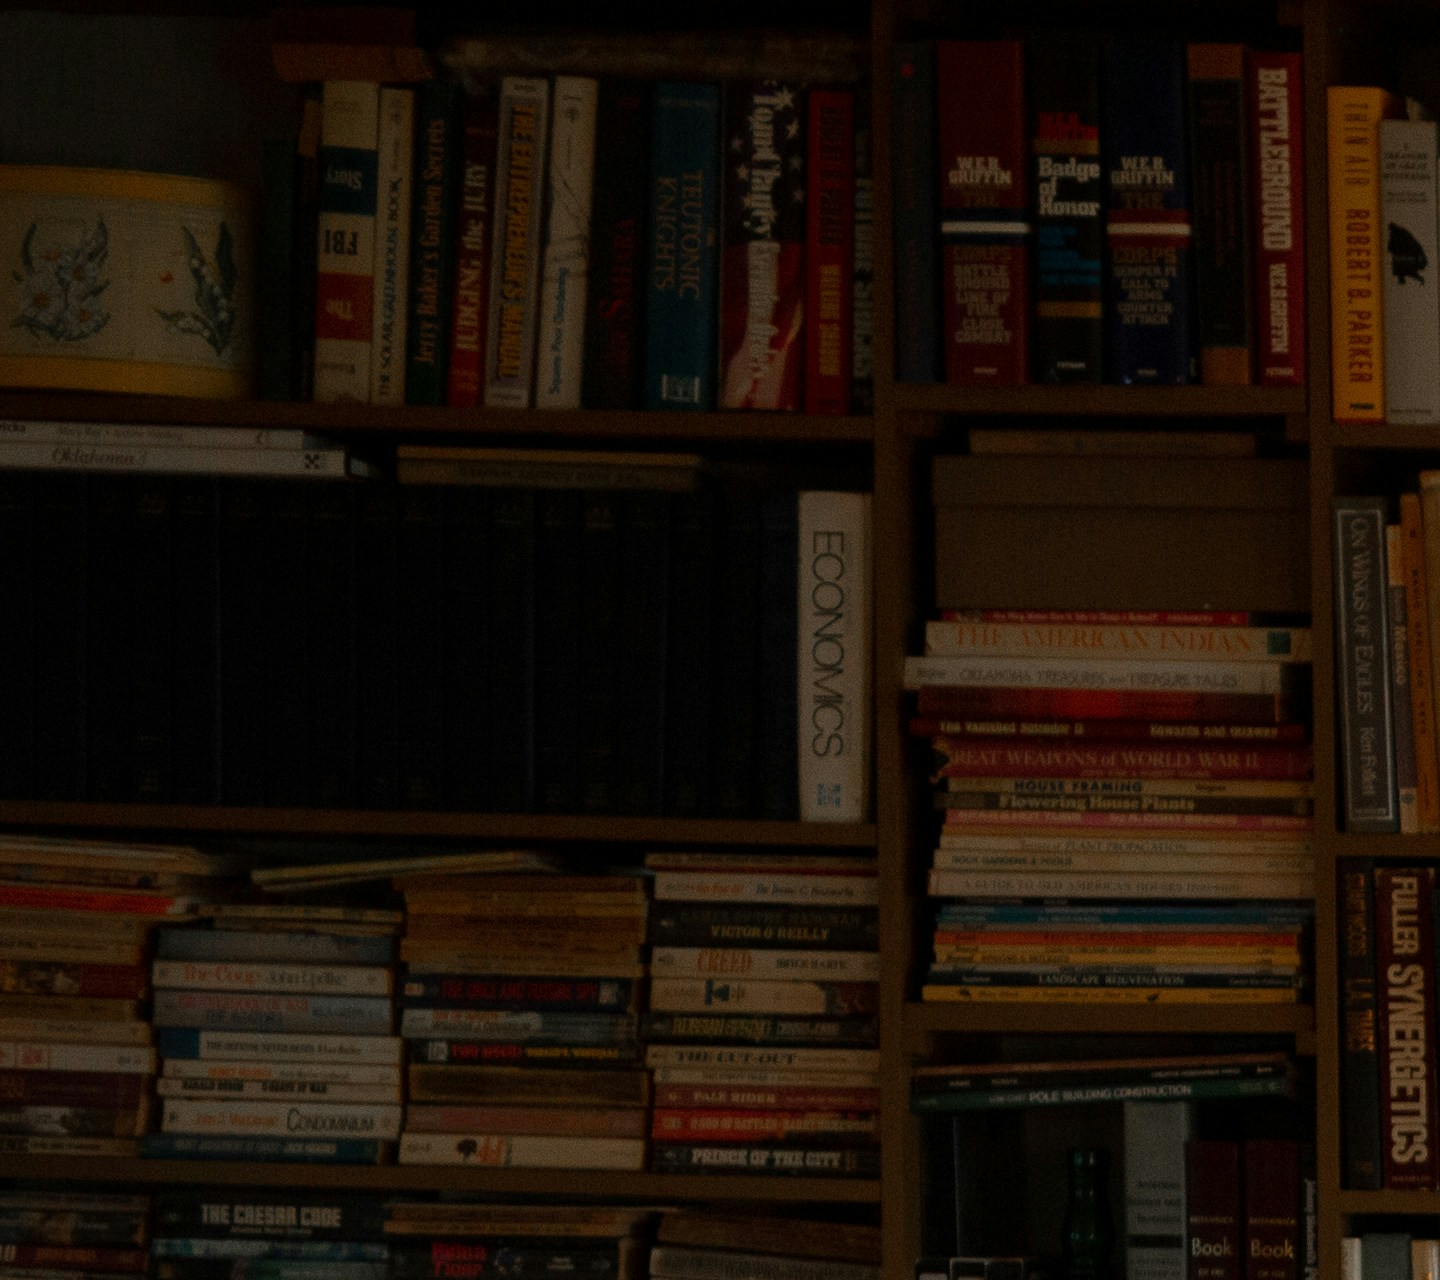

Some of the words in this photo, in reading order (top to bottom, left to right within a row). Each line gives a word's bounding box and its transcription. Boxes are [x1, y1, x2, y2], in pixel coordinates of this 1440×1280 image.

[1343, 103, 1369, 146] THIN
[1345, 153, 1369, 187] AIR
[1346, 208, 1371, 277] ROBERT
[1347, 282, 1371, 304] B.
[1348, 308, 1375, 383] PARKER
[812, 529, 844, 758] ECONOMICS
[1392, 875, 1421, 955] FULLER
[1386, 965, 1430, 1164] SYNERGETICS
[1114, 1084, 1192, 1098] CONSTRUCTION
[1191, 1238, 1232, 1257] Book
[1250, 1240, 1294, 1258] Book
